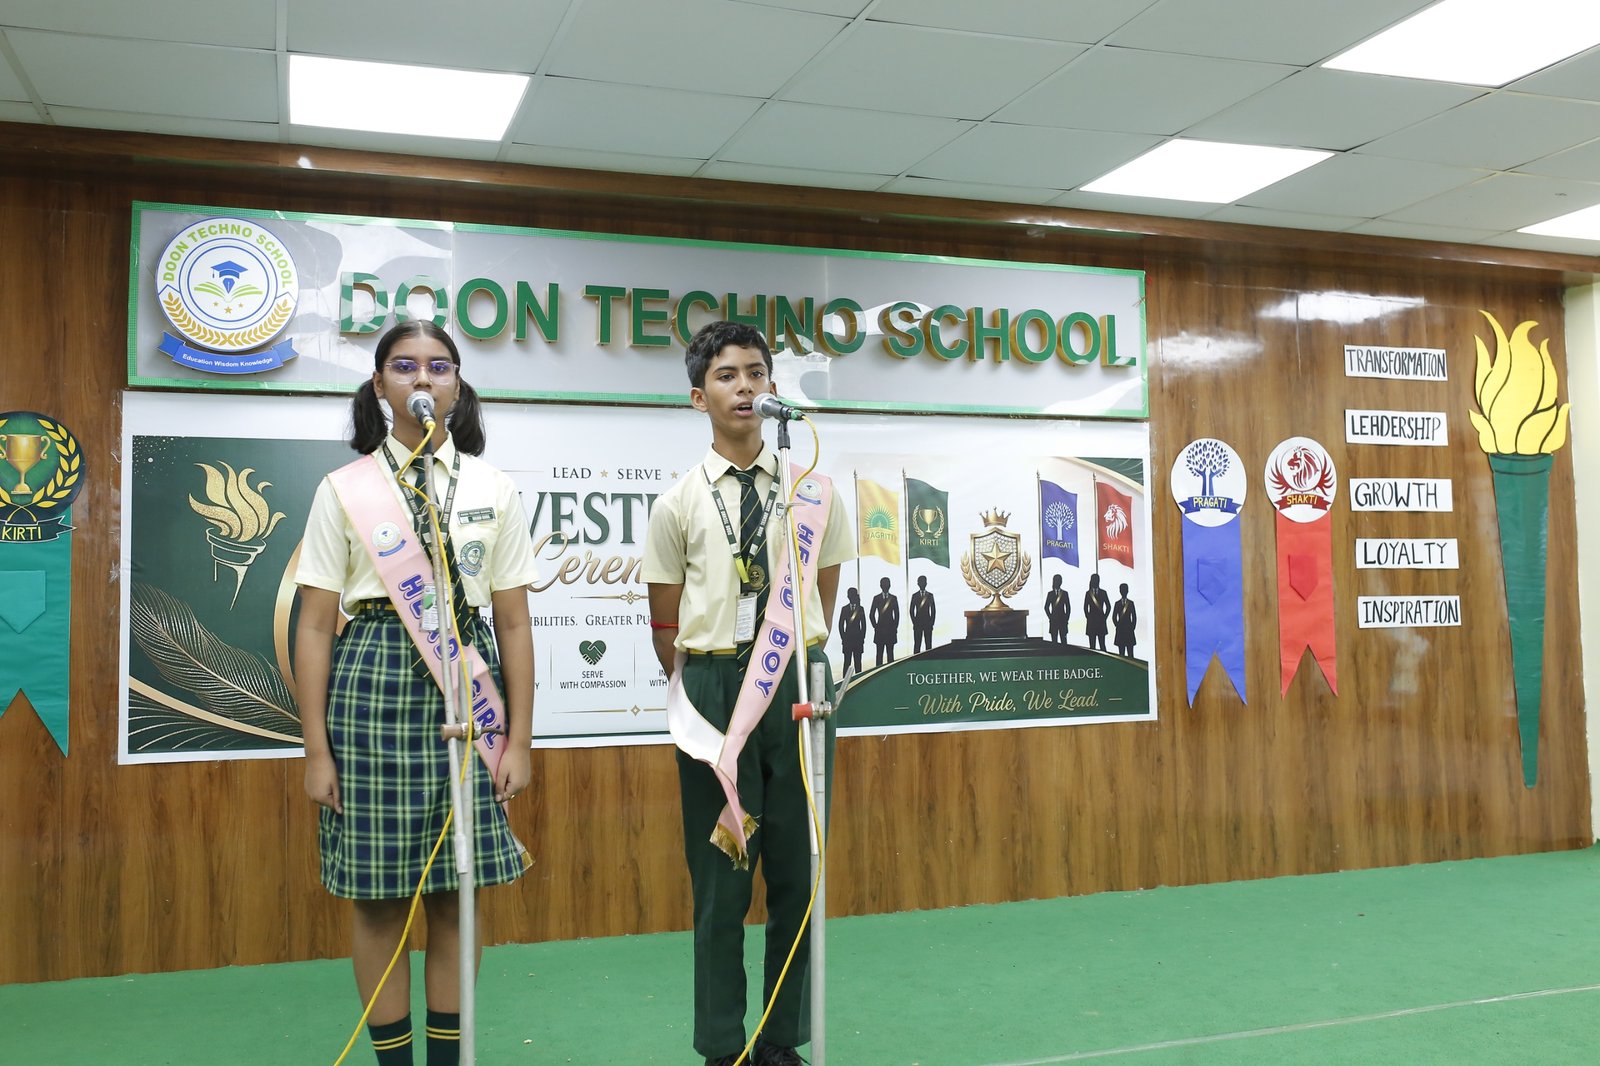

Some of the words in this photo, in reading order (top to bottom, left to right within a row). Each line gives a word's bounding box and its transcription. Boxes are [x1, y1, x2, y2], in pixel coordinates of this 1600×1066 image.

[163, 241, 189, 282] DOON
[187, 223, 253, 243] TECHNO
[256, 234, 294, 288] SCHOOL
[339, 270, 559, 343] DOON
[583, 284, 866, 356] TECHNO
[883, 299, 1137, 368] SCHOOL
[182, 353, 213, 366] Education
[214, 357, 239, 367] Wisdom
[240, 357, 273, 367] Knowledge
[1345, 348, 1447, 378] TRANSFORMATION
[1351, 414, 1442, 441] LEADERSHIP
[553, 467, 592, 479] LEAD
[617, 468, 662, 480] SERVE
[1193, 496, 1228, 509] PRAGATI
[1286, 494, 1318, 505] SHAKTI
[1354, 481, 1439, 509] GROWTH
[519, 491, 659, 545] EST
[2, 526, 42, 541] KIRTI
[919, 538, 939, 546] KIRTI
[1046, 539, 1074, 549] PRAGATI
[1103, 542, 1130, 553] SHAKTI
[1363, 541, 1448, 566] LOYALTY
[780, 522, 814, 610] HED
[398, 574, 461, 662] HD
[585, 614, 633, 626] GREATER
[1362, 599, 1460, 625] INSPIRATION
[755, 626, 790, 698] BOY
[560, 681, 579, 689] WITH
[580, 680, 627, 689] COMPASSION
[581, 670, 604, 679] SERVE
[907, 672, 976, 685] TOGETHER,
[979, 671, 997, 683] WE
[1000, 670, 1034, 682] WEAR
[1037, 669, 1060, 680] THE
[1063, 667, 1104, 679] BADGE.
[918, 693, 963, 715] With
[969, 691, 1017, 713] Pride,
[1023, 689, 1053, 711] We
[1058, 688, 1100, 711] Lead.
